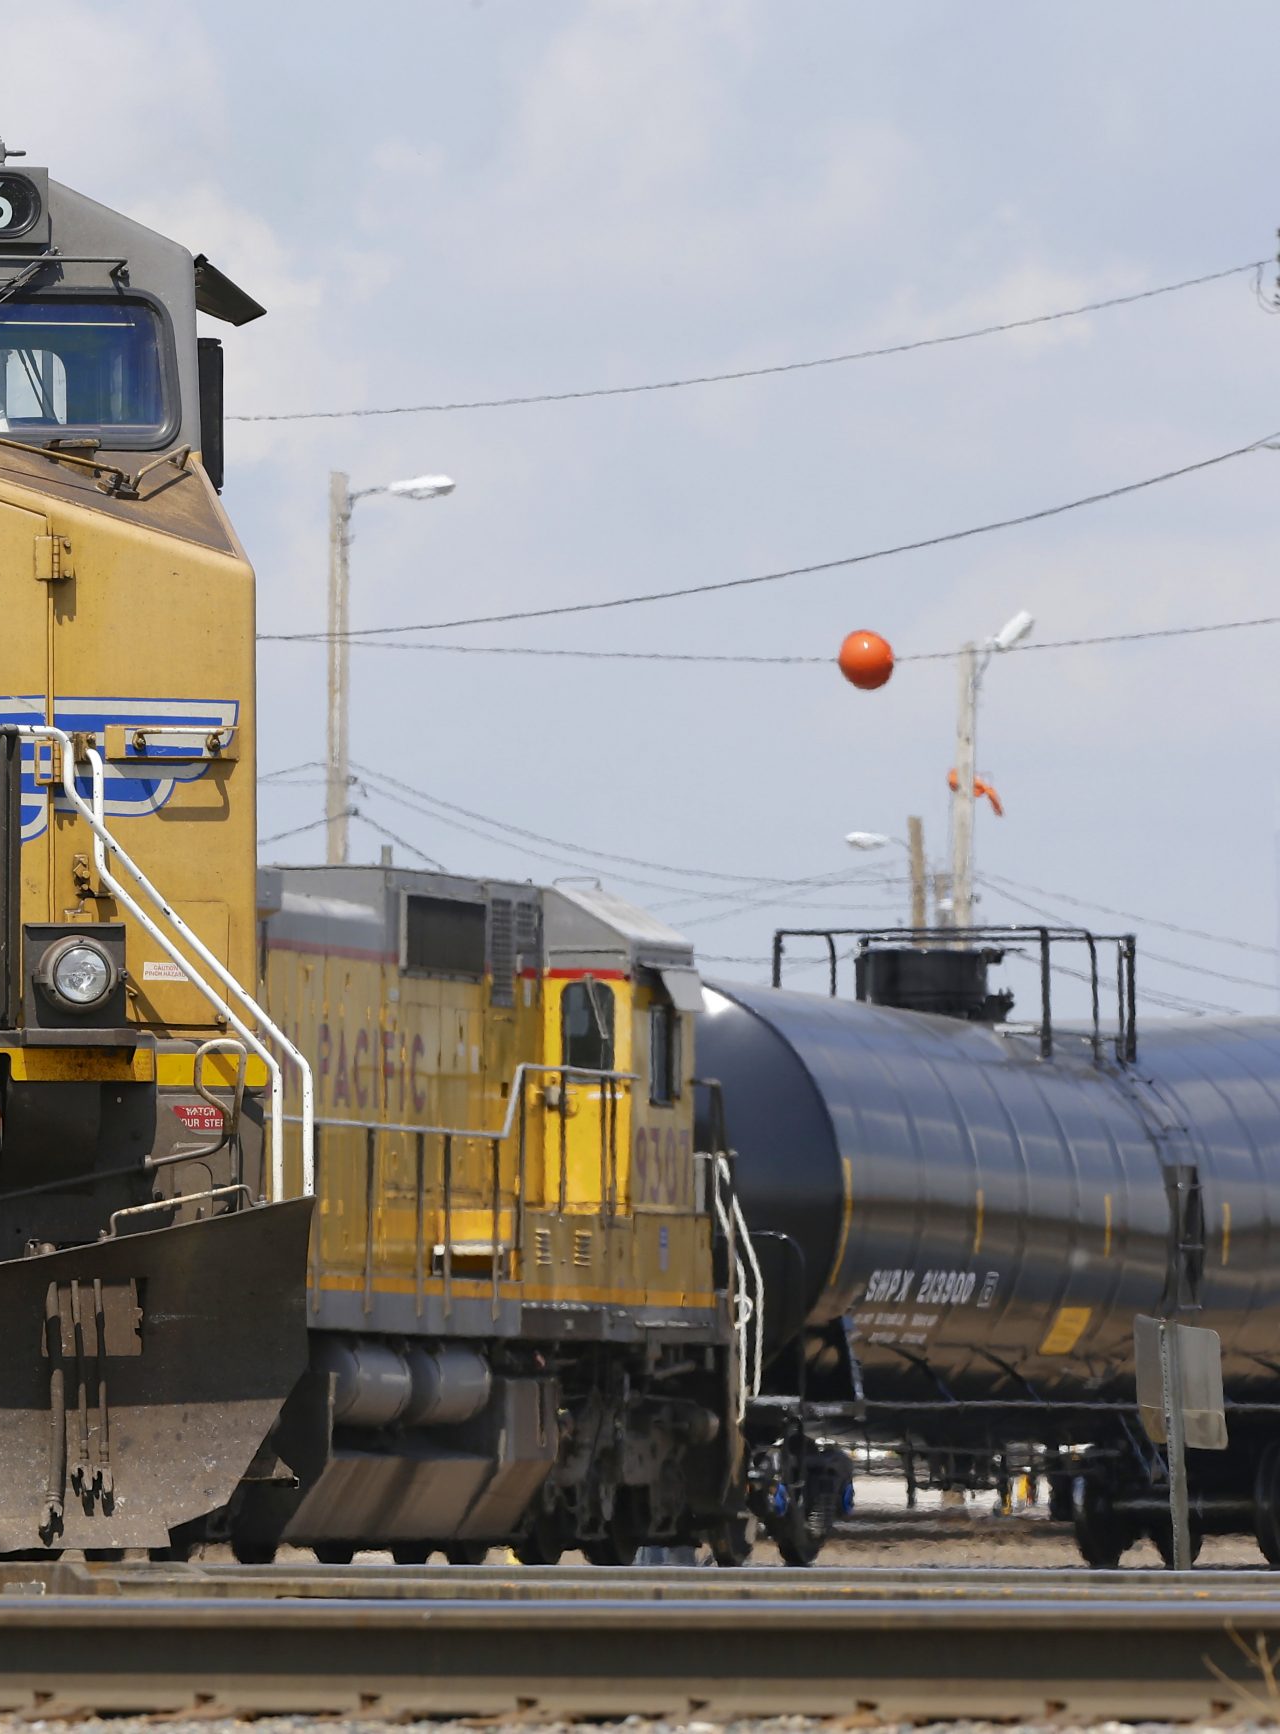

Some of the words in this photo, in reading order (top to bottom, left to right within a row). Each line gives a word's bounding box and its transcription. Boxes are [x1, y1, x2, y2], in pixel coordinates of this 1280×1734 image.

[318, 1023, 426, 1113] PACIFIC
[184, 1106, 217, 1117] WATCH
[180, 1118, 200, 1128] OUR
